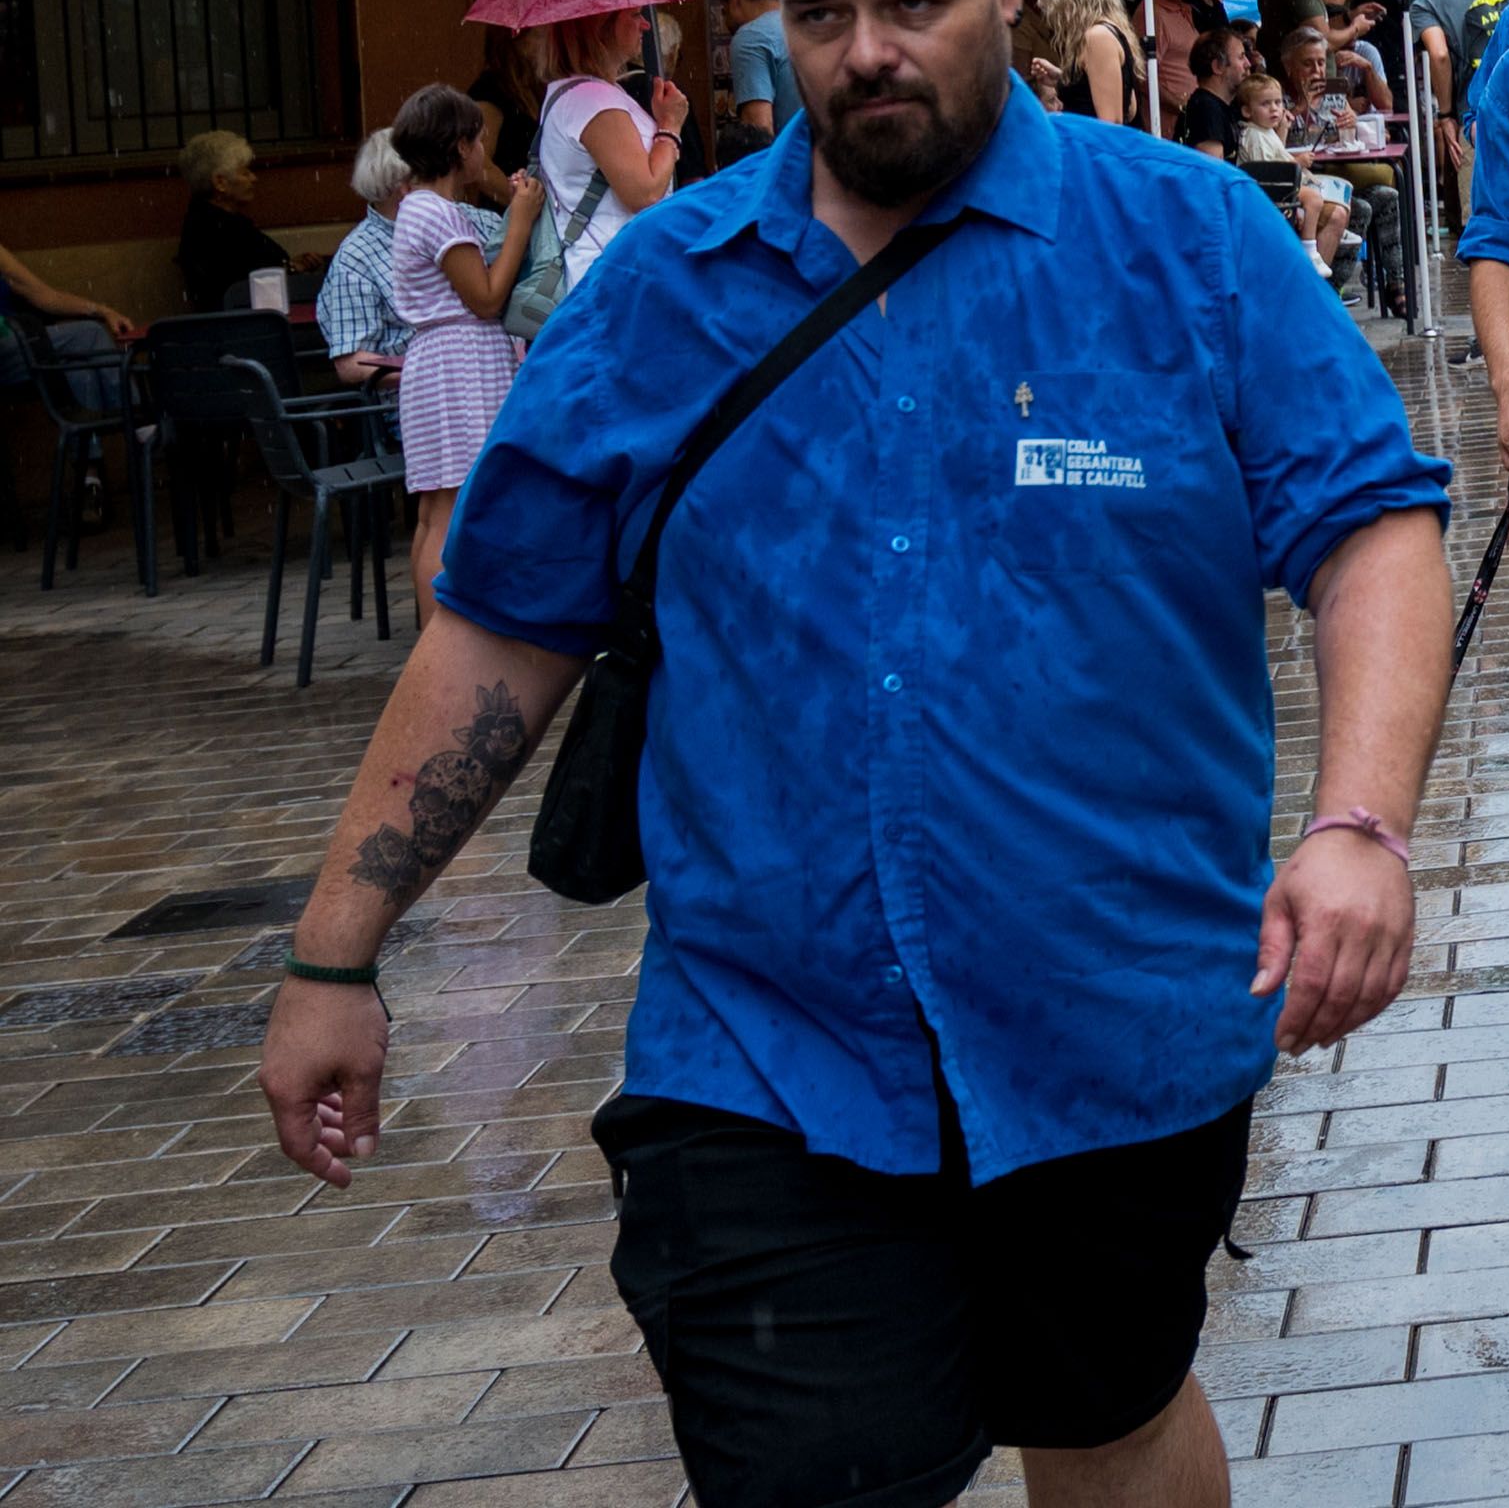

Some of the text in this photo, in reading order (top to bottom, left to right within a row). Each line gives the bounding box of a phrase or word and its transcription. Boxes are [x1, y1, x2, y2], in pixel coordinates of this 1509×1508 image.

[1066, 439, 1107, 454] COLLA
[1066, 455, 1143, 472] GEGANTERA
[1066, 471, 1147, 489] DE CALAFELL
